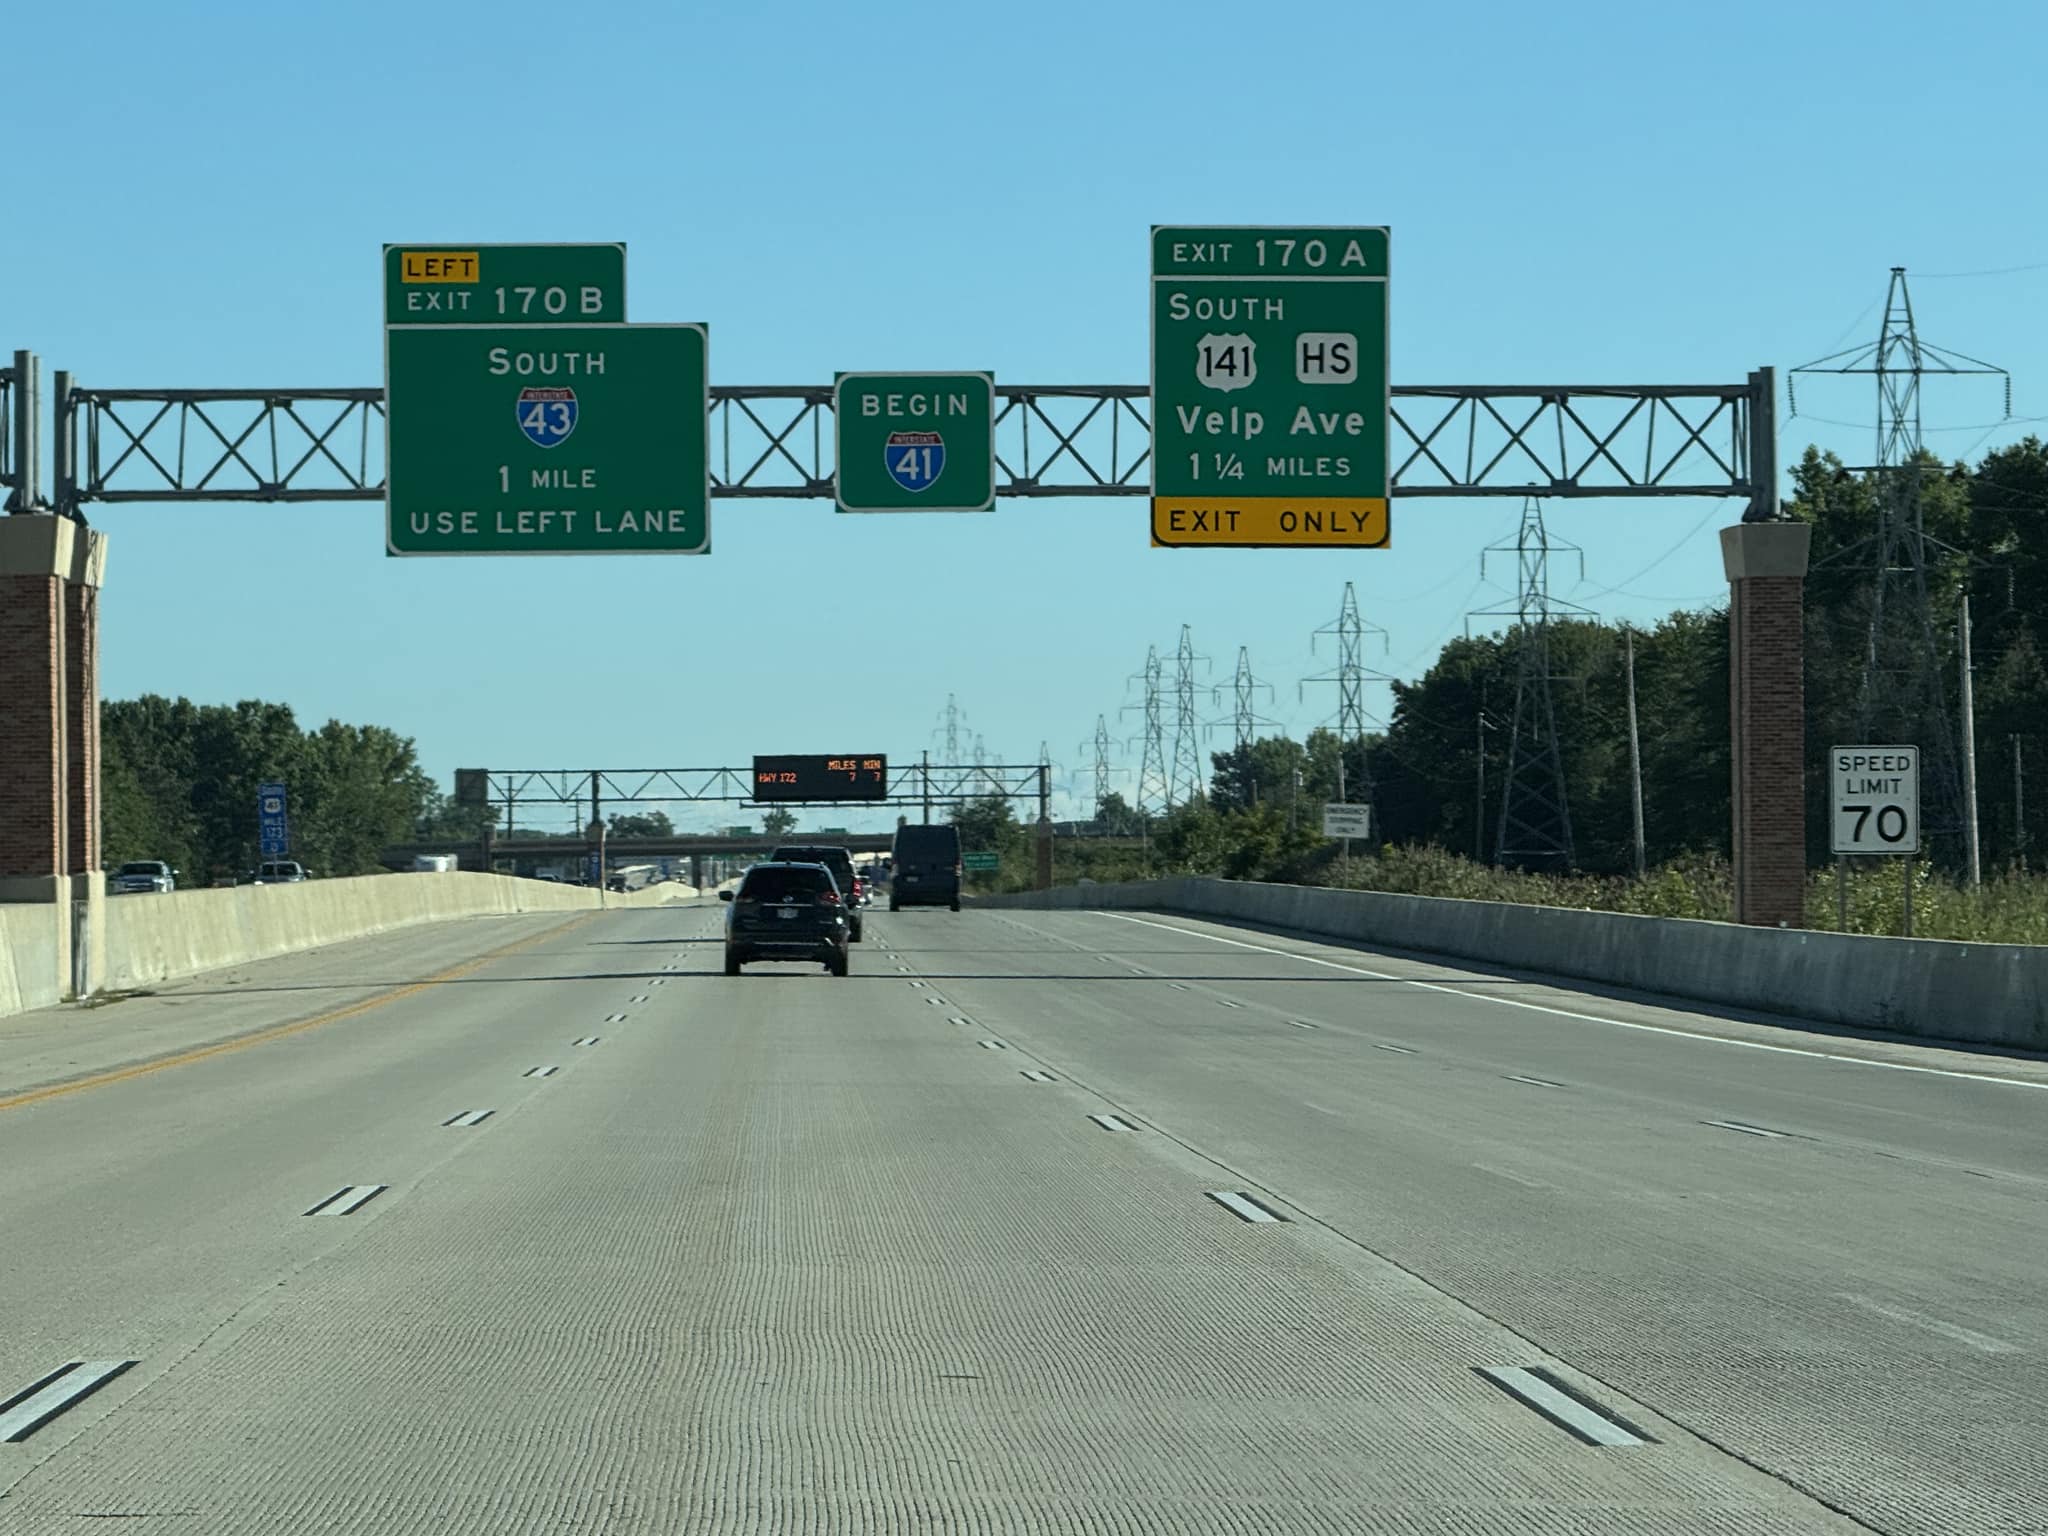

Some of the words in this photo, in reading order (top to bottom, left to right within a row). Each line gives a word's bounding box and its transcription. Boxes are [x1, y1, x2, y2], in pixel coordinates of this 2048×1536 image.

[1173, 243, 1233, 262] EXIT
[1256, 239, 1327, 267] 170
[1341, 240, 1367, 267] A
[406, 258, 475, 277] LEFT
[407, 291, 472, 311] EXIT
[495, 287, 567, 314] 170
[581, 286, 603, 314] B
[1169, 293, 1284, 320] SOUTH
[489, 348, 605, 375] SOUTH
[1203, 346, 1249, 377] 141
[1303, 343, 1352, 374] HS
[523, 402, 571, 435] 43
[862, 394, 968, 416] BEGIN
[1176, 405, 1264, 440] Velp
[1290, 406, 1365, 435] Ave
[896, 448, 932, 480] 41
[1267, 457, 1351, 476] MILES
[500, 465, 509, 493] 1
[532, 469, 597, 488] MILE
[410, 512, 478, 534] USE
[497, 511, 576, 533] LEFT
[596, 510, 686, 533] LANE
[1170, 510, 1240, 532] EXIT
[1280, 511, 1370, 533] ONLY
[828, 760, 857, 771] MILES
[1839, 756, 1910, 772] SPEED
[1847, 778, 1902, 794] LIMIT
[1842, 805, 1907, 843] 70
